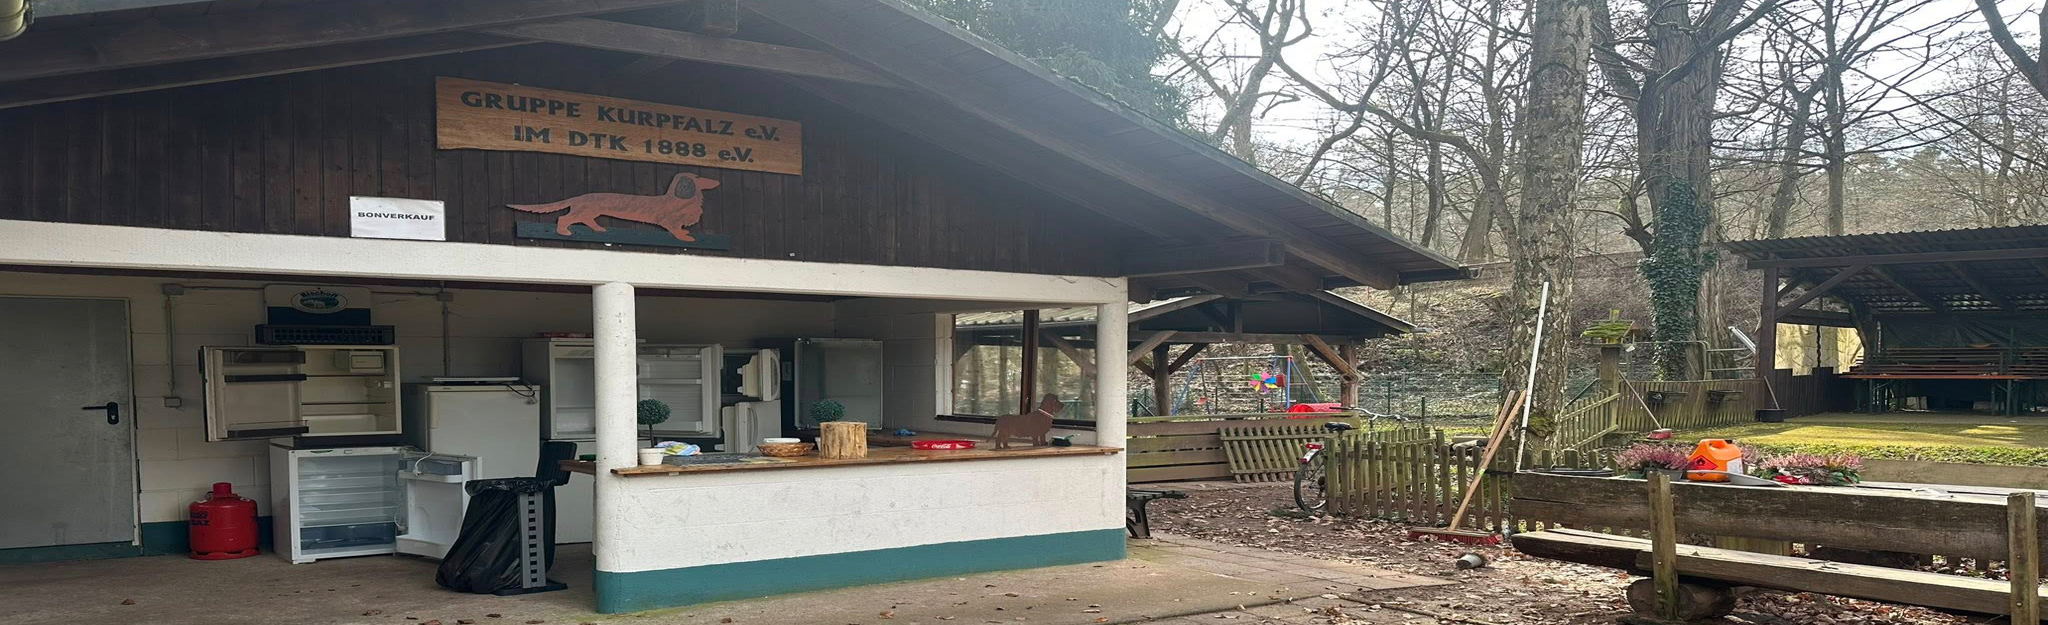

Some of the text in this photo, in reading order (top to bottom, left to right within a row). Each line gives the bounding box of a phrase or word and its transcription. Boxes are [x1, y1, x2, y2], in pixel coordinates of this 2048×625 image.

[461, 91, 780, 142] GRUPPE KURPFALZ e.V.
[513, 125, 755, 163] IM DTK 1888 e.V.
[357, 212, 435, 220] BONVERKAUF
